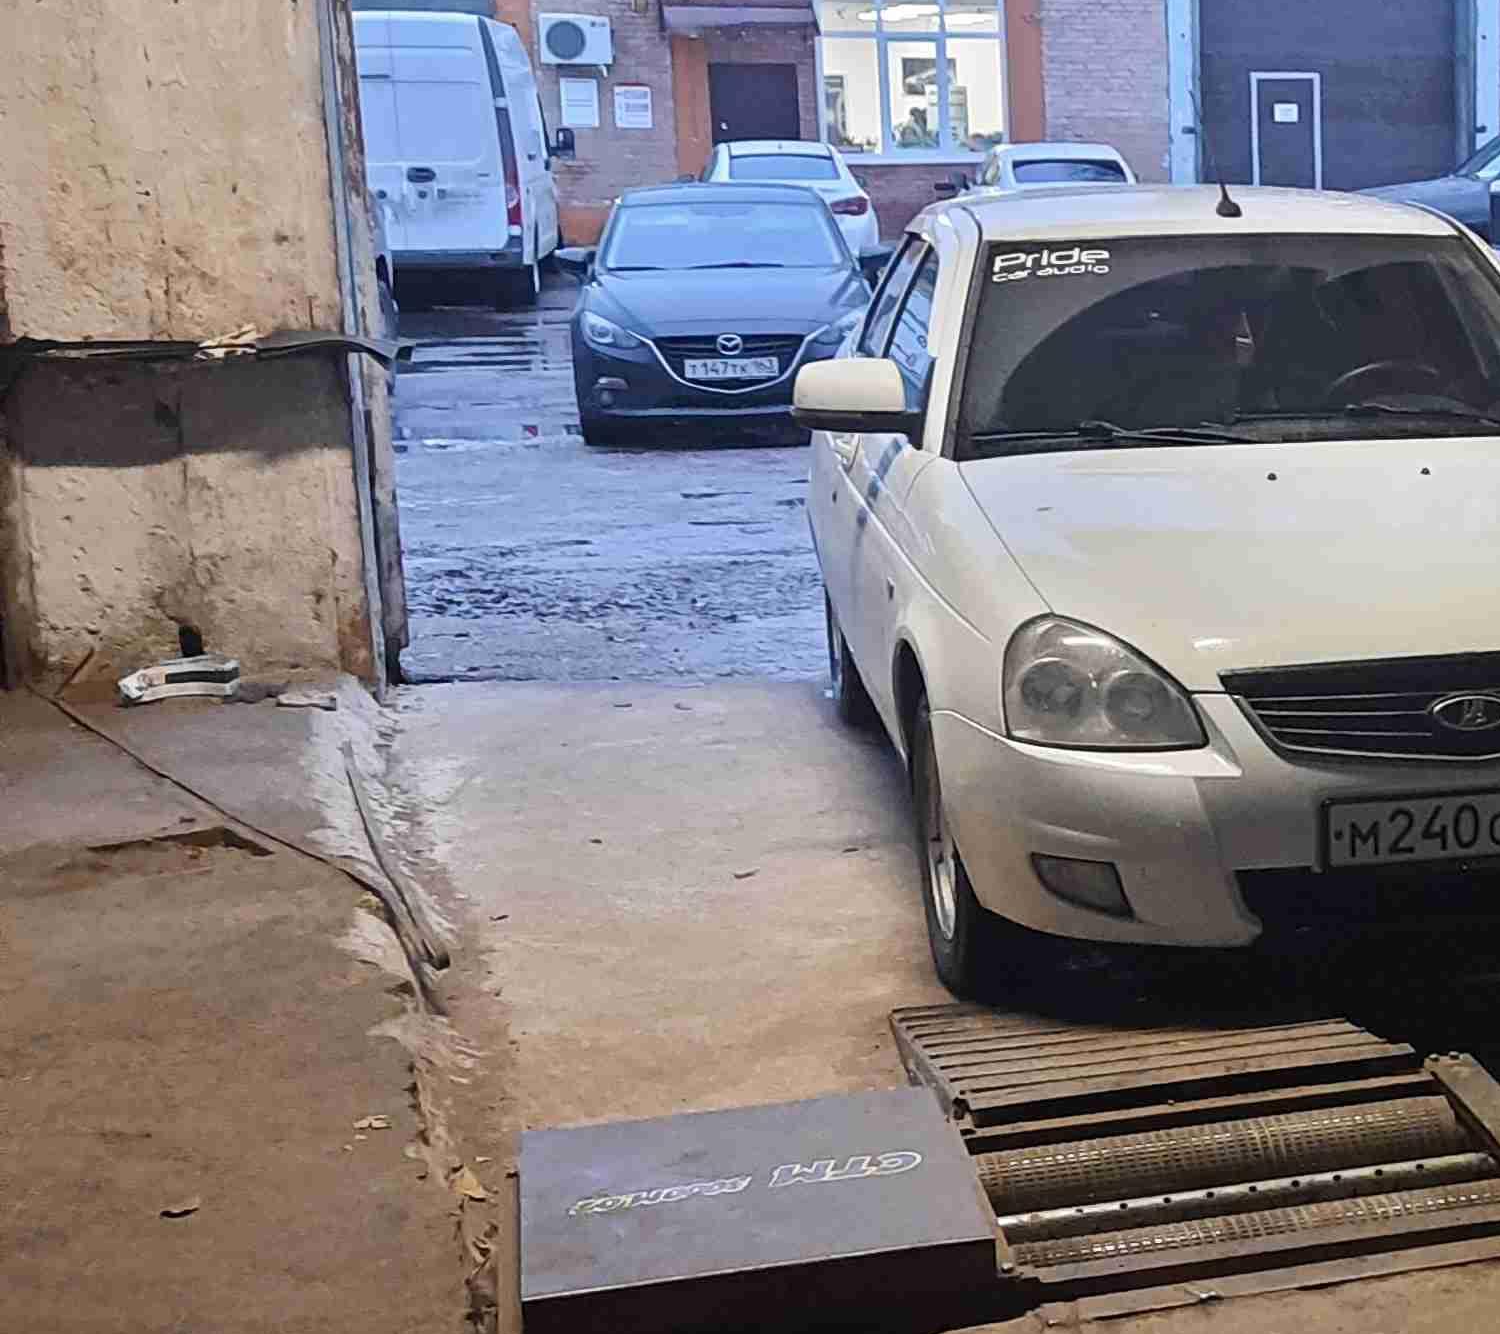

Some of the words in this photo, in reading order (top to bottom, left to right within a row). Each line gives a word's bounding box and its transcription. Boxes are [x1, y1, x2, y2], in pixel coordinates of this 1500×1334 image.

[992, 247, 1110, 273] Pride
[992, 269, 1033, 283] car
[1036, 264, 1110, 276] audio
